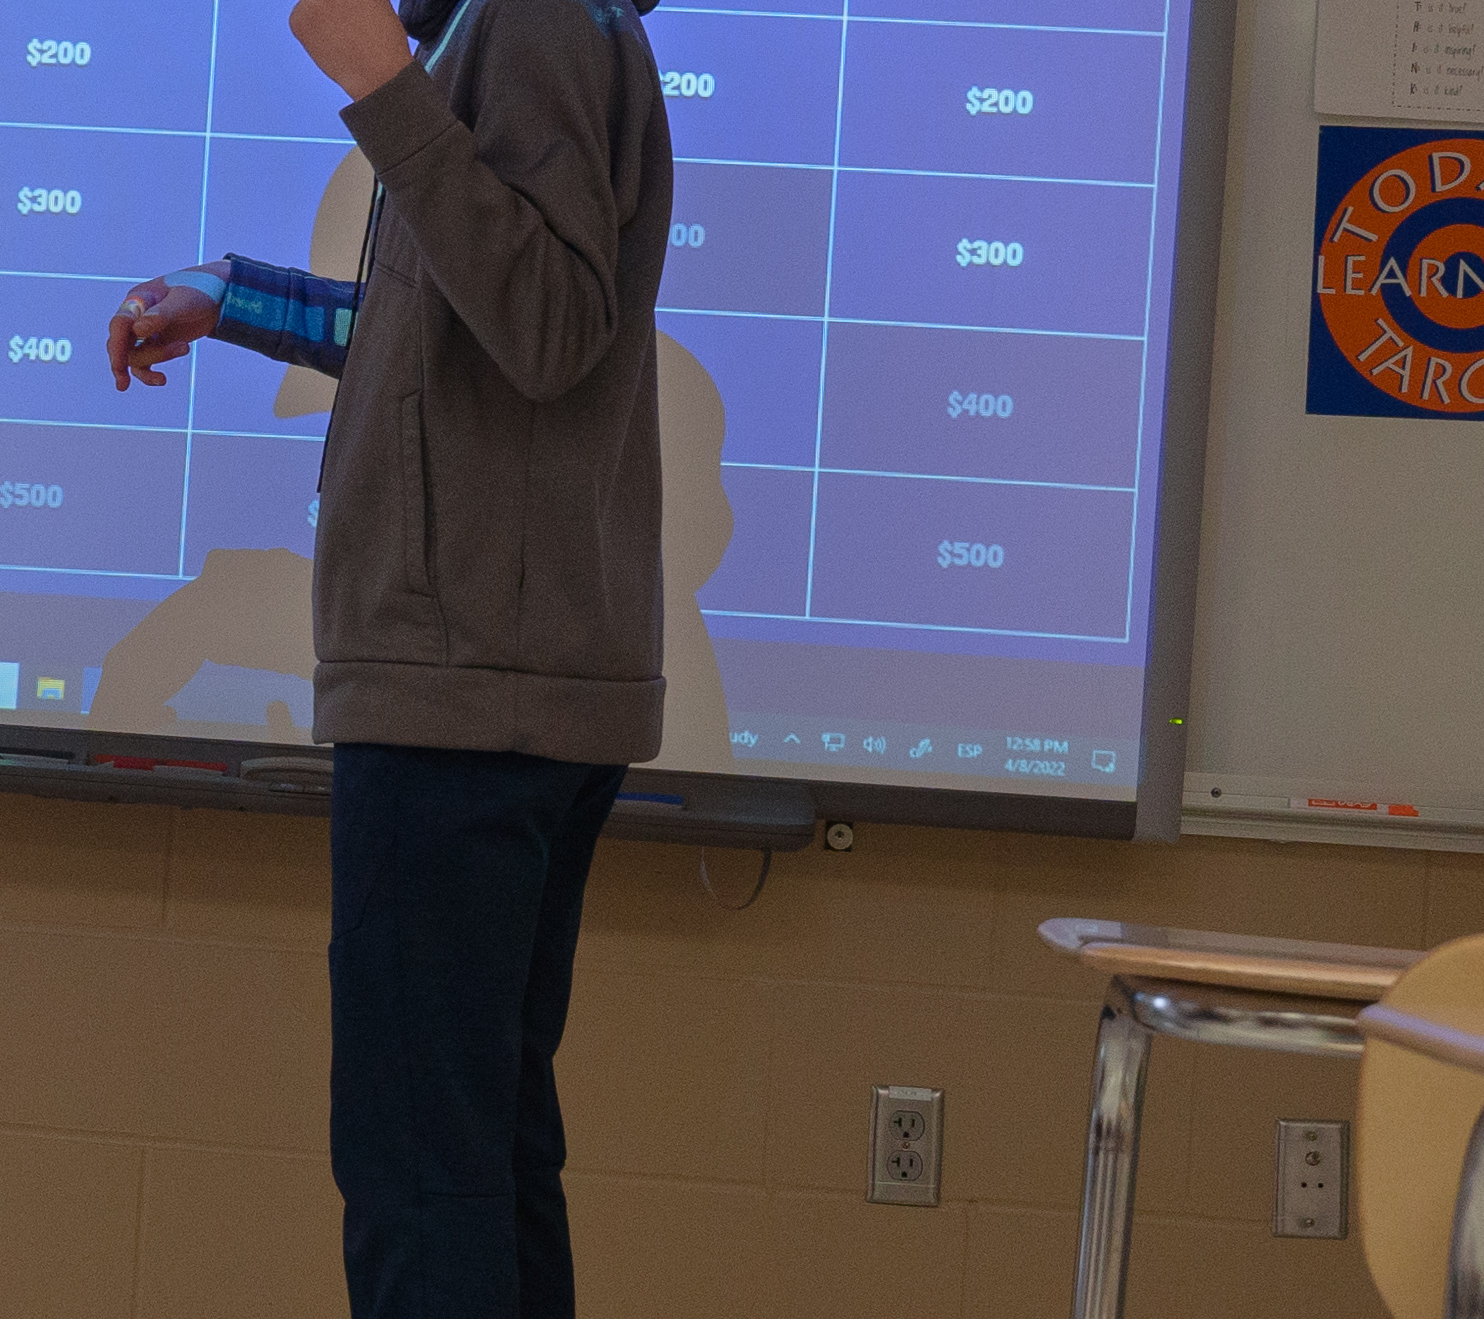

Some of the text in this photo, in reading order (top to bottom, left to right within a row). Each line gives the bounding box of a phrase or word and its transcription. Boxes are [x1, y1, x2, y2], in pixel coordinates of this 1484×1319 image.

[26, 37, 92, 69] $200
[659, 70, 716, 99] 200
[966, 86, 1034, 116] $200
[17, 185, 82, 216] $300
[956, 238, 1024, 268] $300
[8, 333, 72, 365] $400
[947, 390, 1014, 421] $400
[0, 480, 64, 511] $500
[937, 539, 1004, 570] $500
[957, 742, 983, 759] ESP
[1043, 738, 1070, 754] PM
